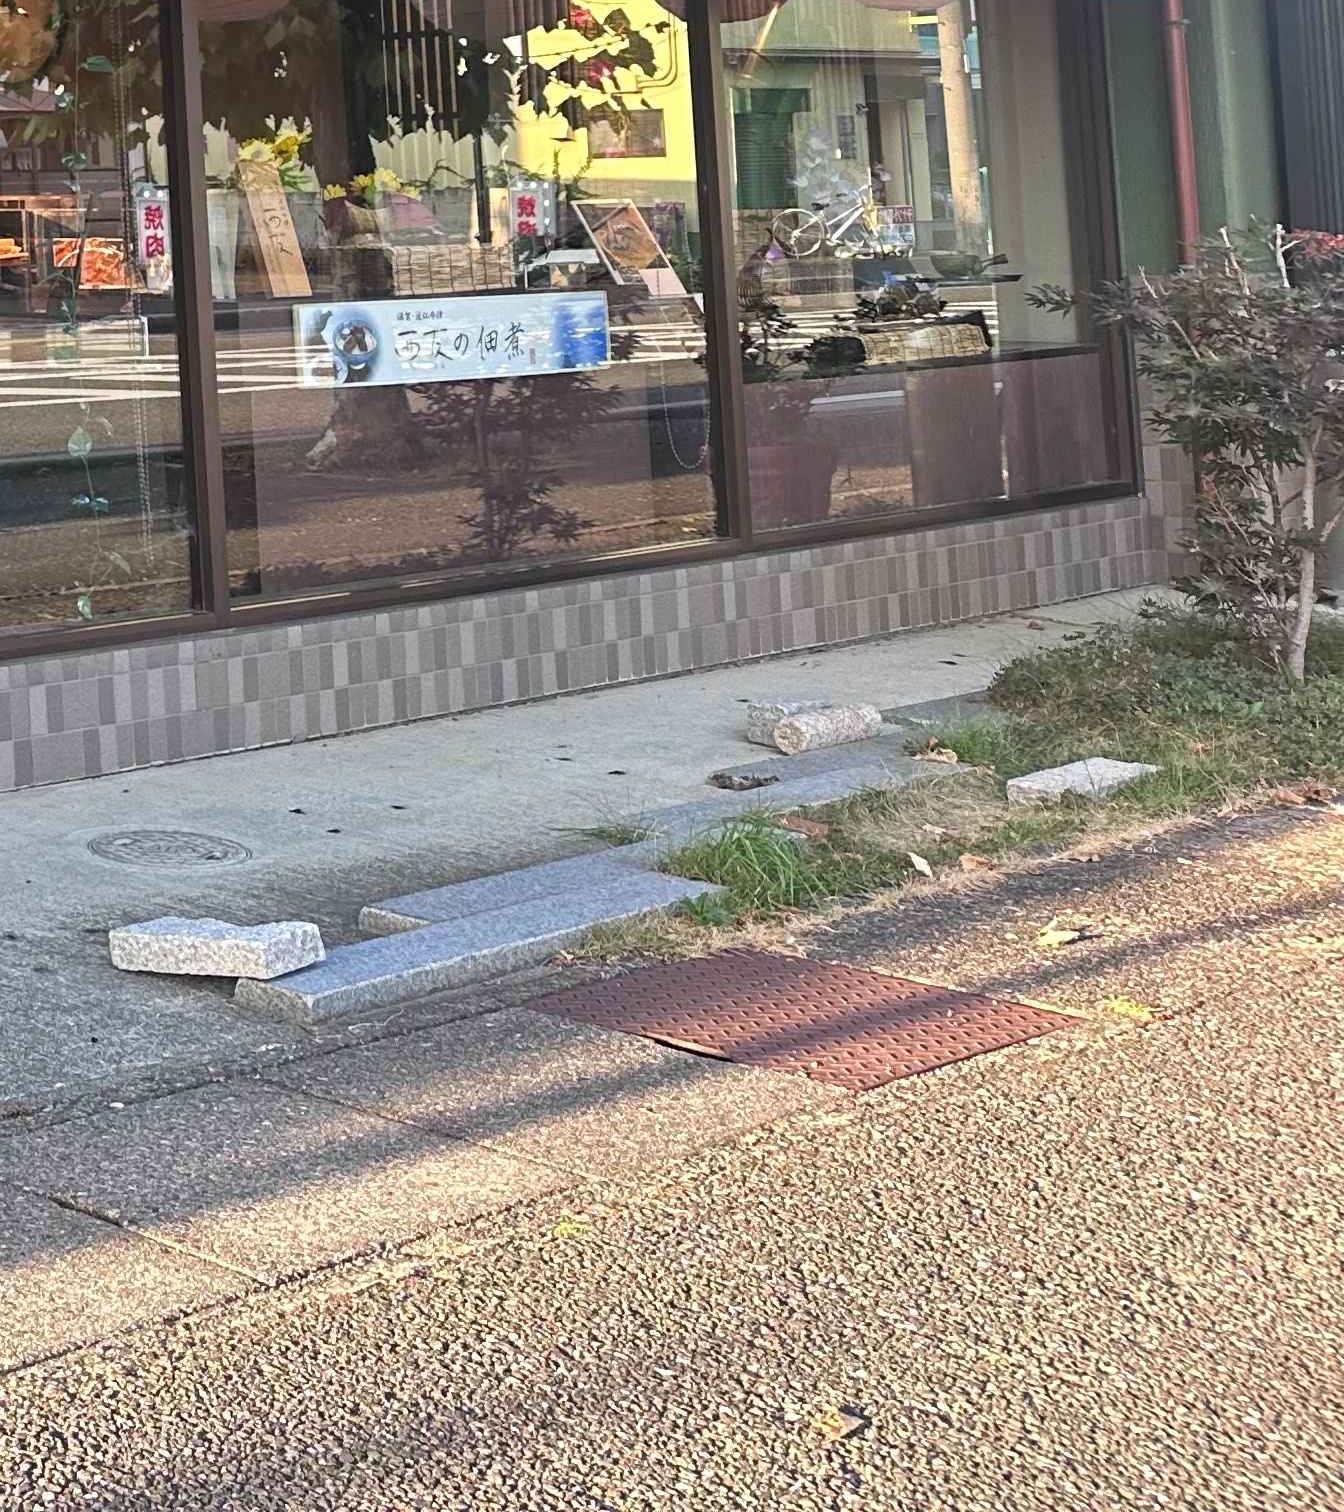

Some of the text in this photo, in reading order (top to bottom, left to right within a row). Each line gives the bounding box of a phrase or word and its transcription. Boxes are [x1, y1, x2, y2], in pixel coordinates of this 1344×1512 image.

[394, 321, 526, 361] 西友の佃煮
